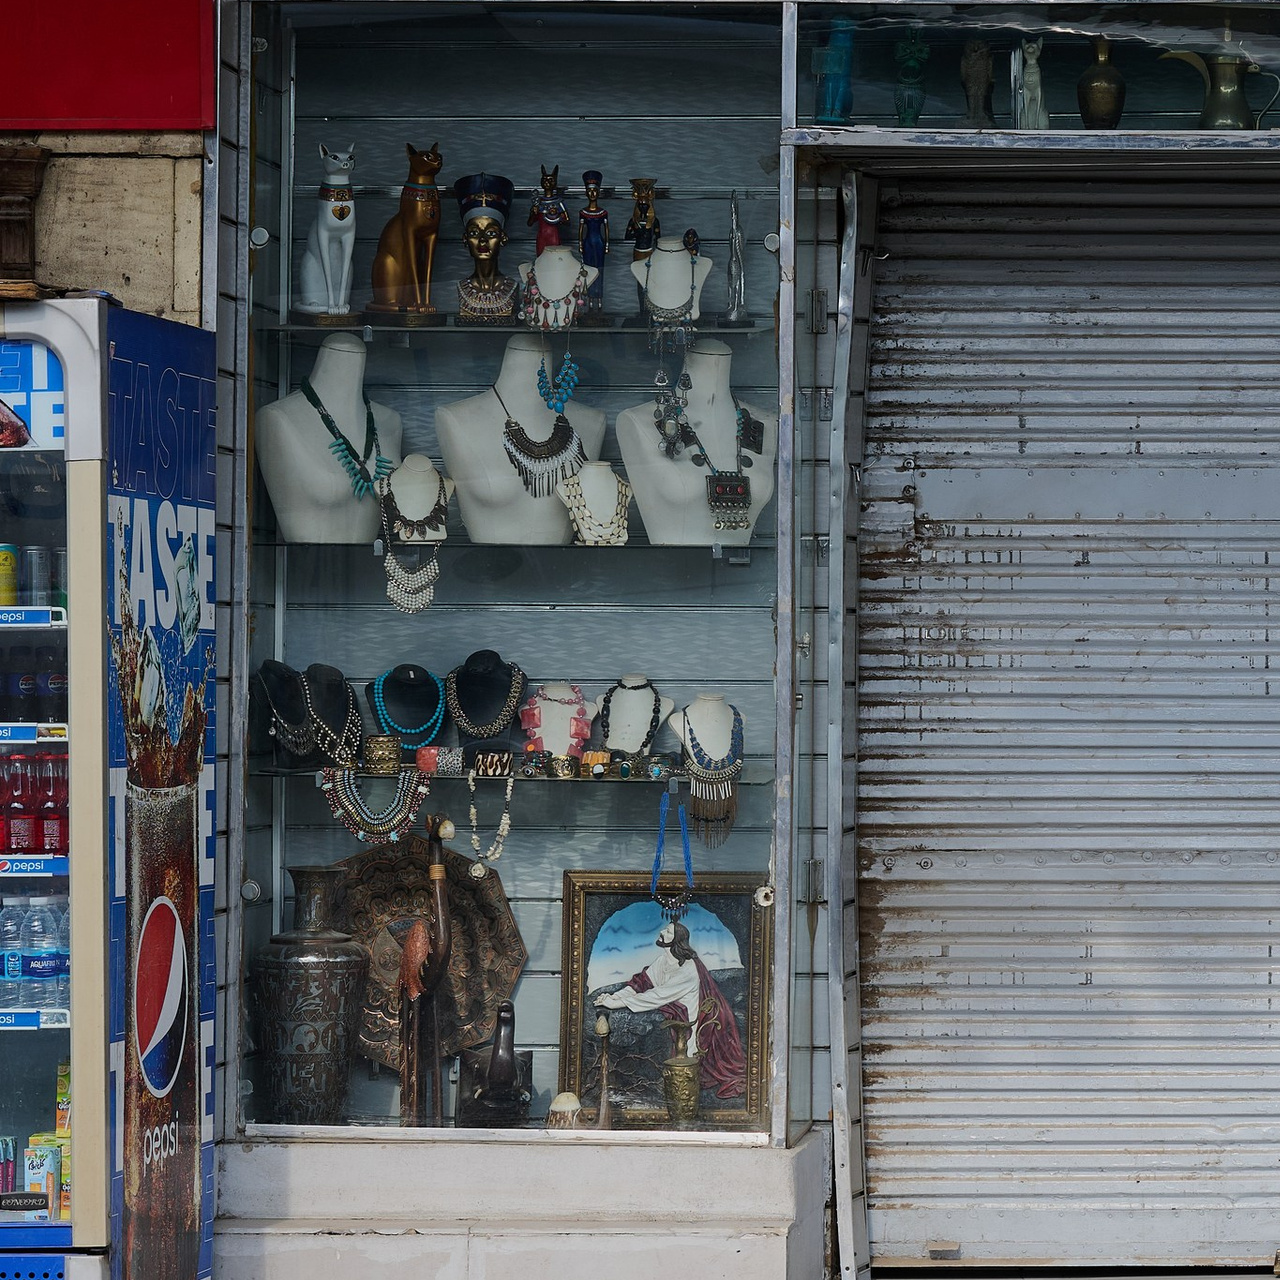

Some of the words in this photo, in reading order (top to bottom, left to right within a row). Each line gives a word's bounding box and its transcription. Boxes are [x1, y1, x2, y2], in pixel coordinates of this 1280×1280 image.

[108, 356, 217, 504] TASTE
[107, 494, 216, 631] TASTE
[0, 611, 25, 623] epsi
[12, 861, 44, 872] pepsi
[143, 1110, 179, 1178] pepsi
